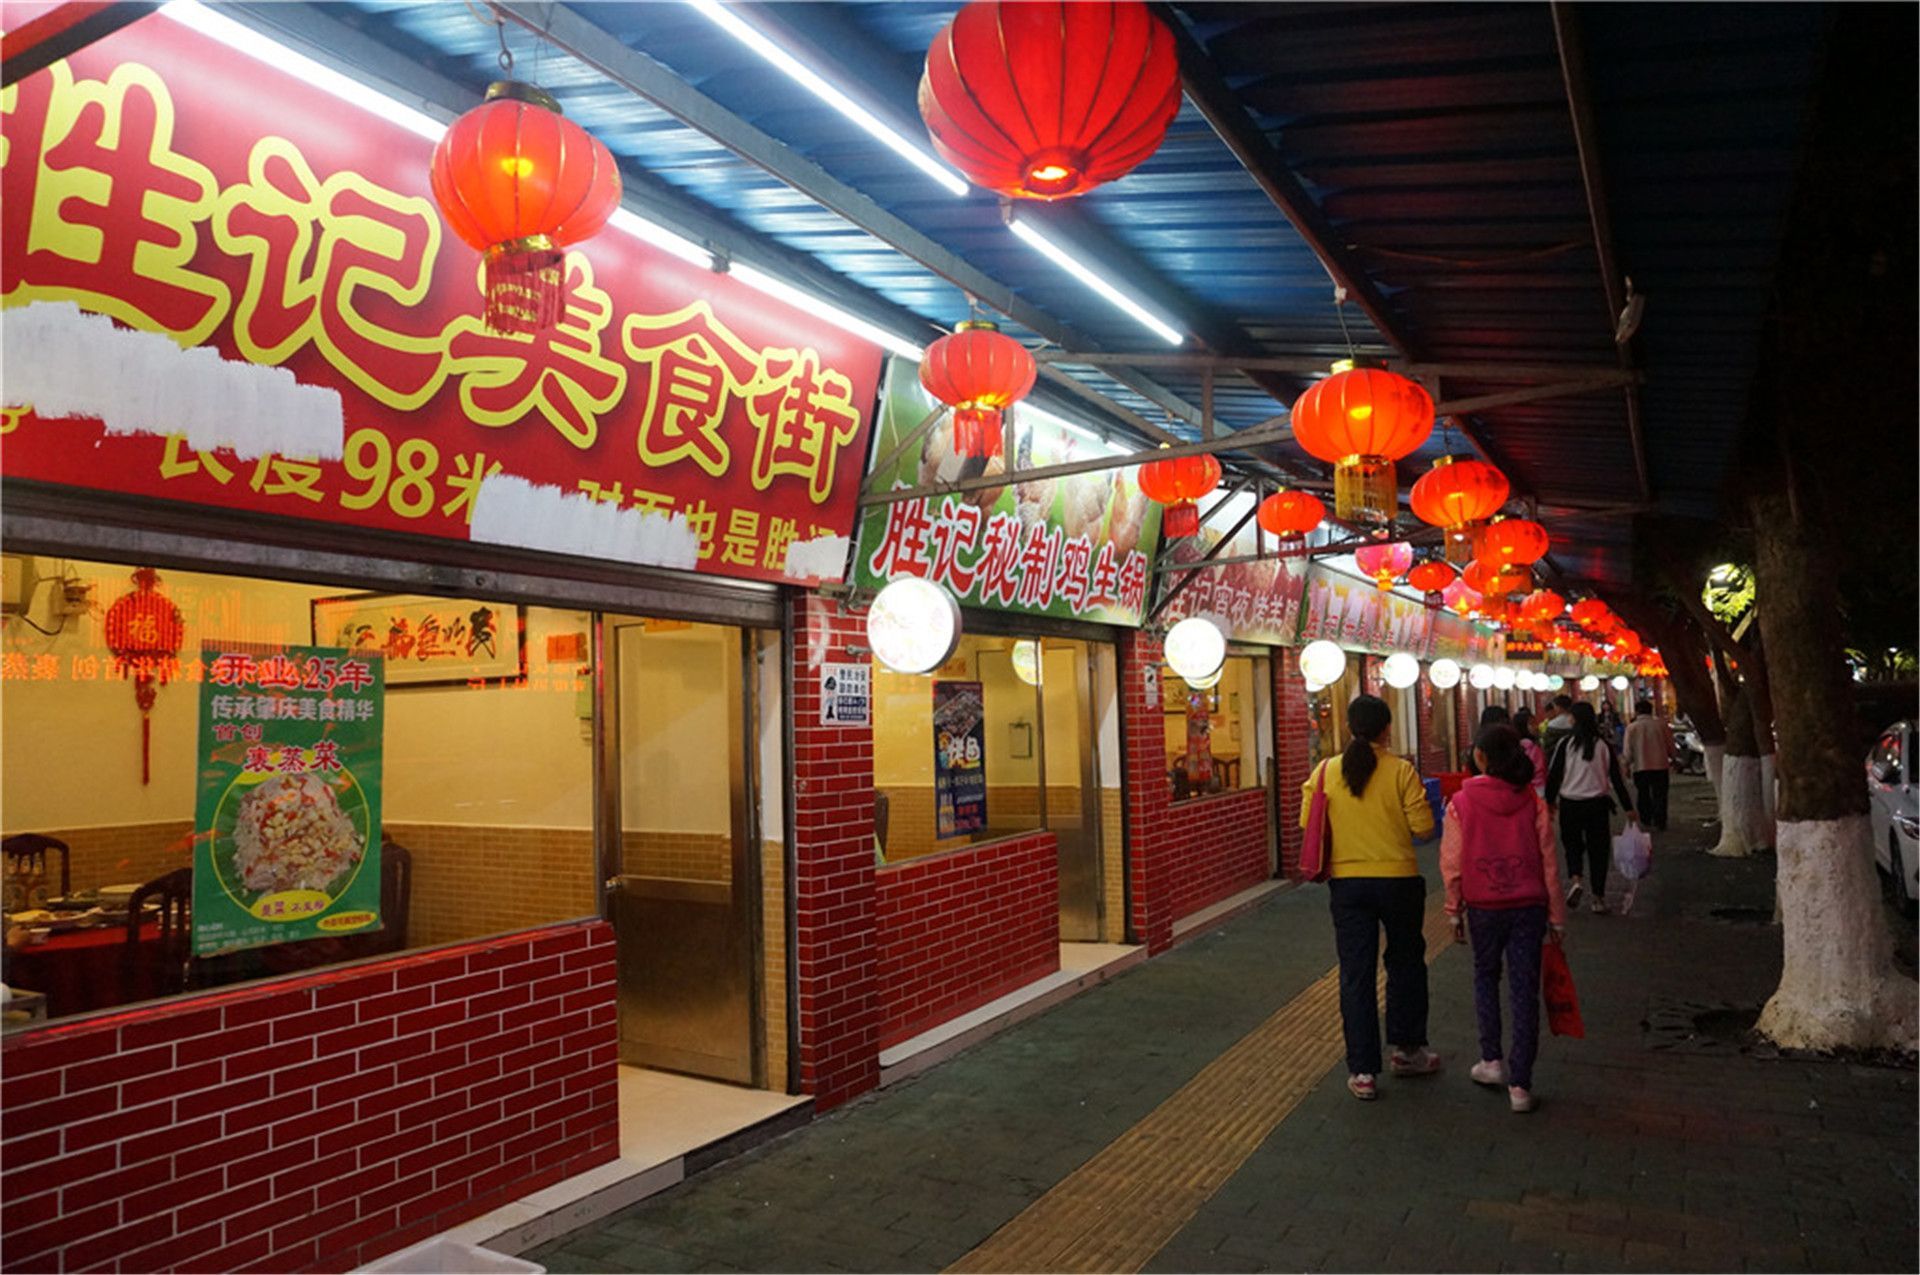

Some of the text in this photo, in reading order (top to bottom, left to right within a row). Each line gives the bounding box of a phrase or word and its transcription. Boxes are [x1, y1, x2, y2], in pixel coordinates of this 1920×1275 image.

[870, 480, 1148, 616] 胜记秘制鸡生锅
[217, 653, 374, 693] 开业25年
[210, 694, 374, 722] 传承肇庆美食精华
[212, 722, 263, 741] 首创
